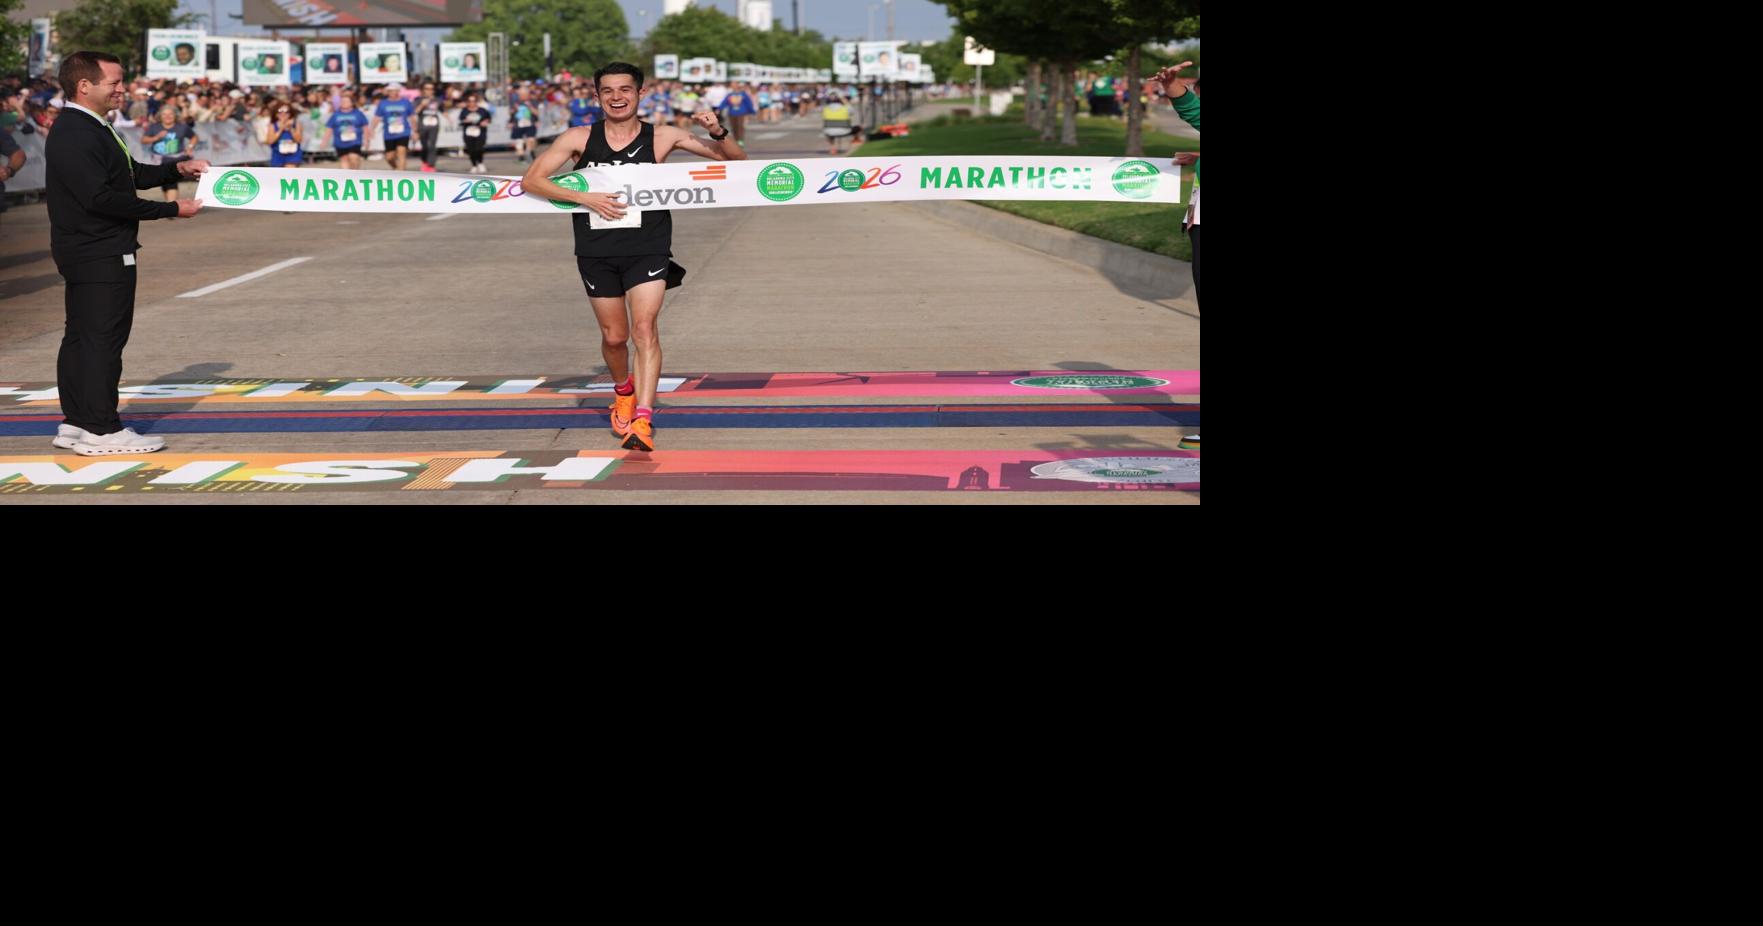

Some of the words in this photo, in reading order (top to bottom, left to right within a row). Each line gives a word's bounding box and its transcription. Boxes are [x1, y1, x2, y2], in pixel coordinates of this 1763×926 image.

[280, 178, 436, 202] MARATHON
[817, 164, 902, 194] 2026
[919, 166, 1092, 190] MARATHON
[614, 184, 717, 207] devon
